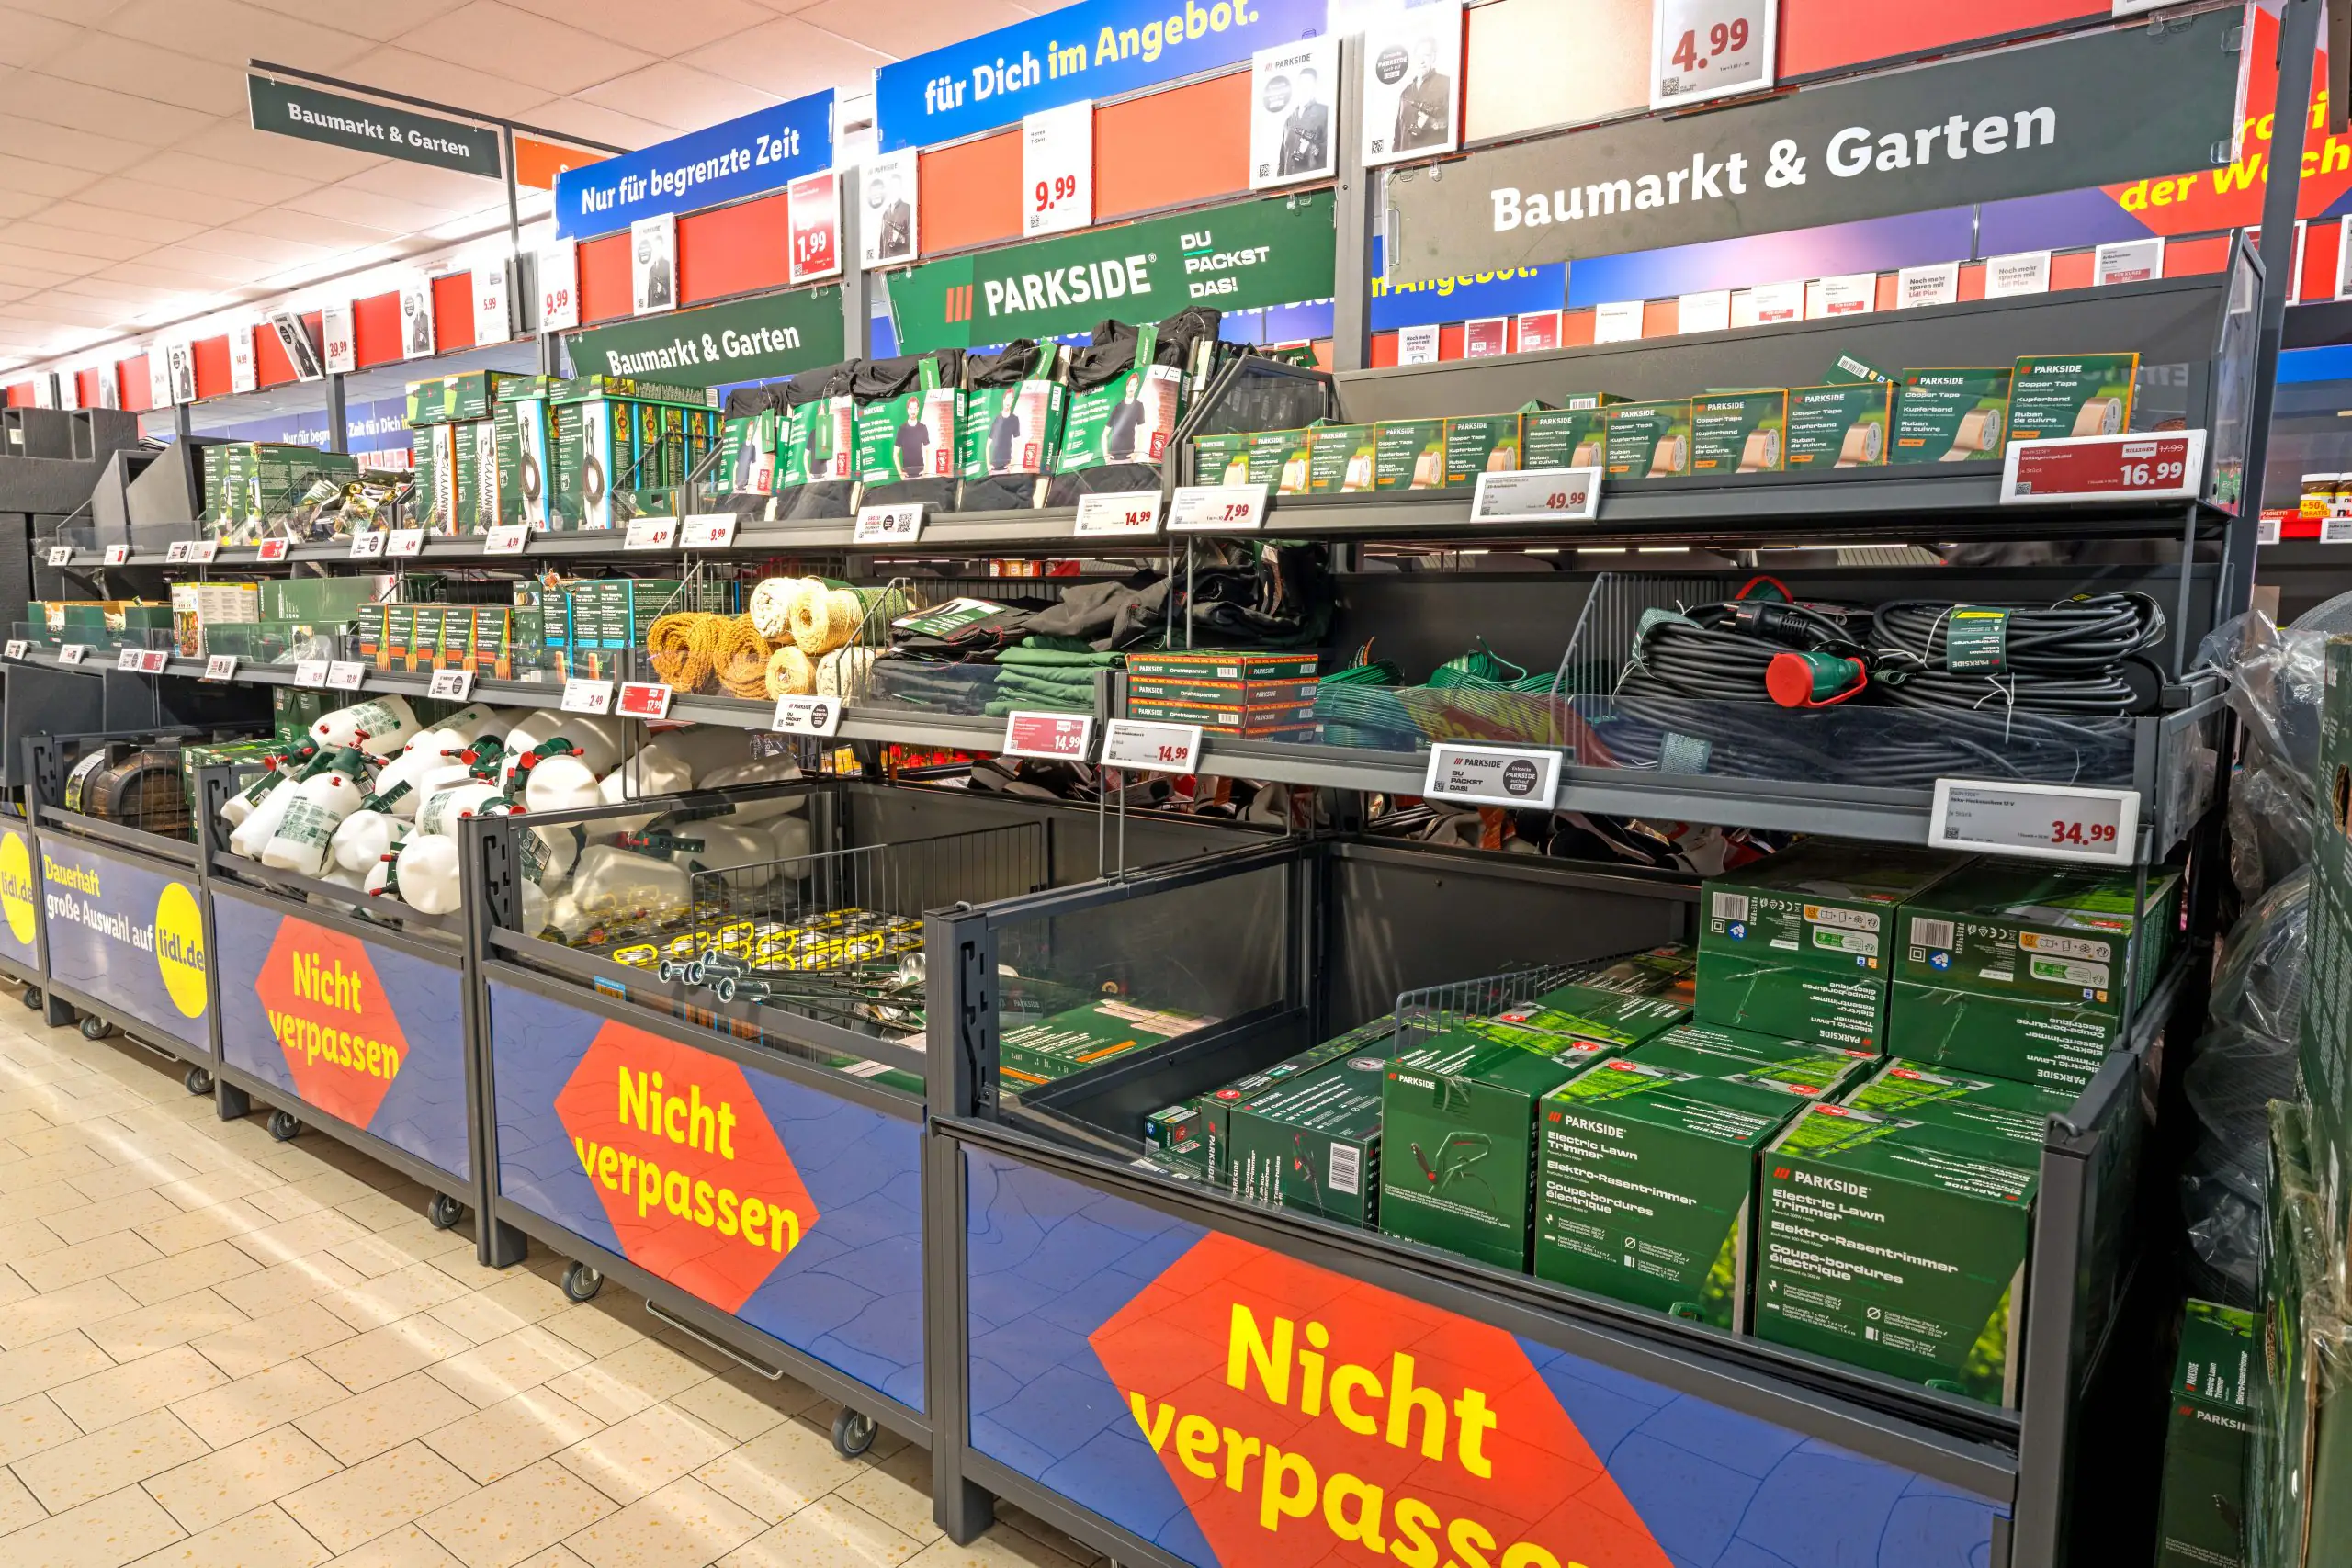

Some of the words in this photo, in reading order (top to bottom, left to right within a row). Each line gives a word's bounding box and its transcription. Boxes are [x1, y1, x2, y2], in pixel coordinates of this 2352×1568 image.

[1672, 18, 1748, 72] 4.99
[924, 77, 963, 115] für
[973, 52, 1040, 103] Dich
[1047, 40, 1087, 80] im
[1094, 0, 1259, 66] Angebot.
[288, 102, 385, 141] Baumarkt
[389, 125, 403, 144] &
[408, 130, 469, 158] Garten
[582, 186, 614, 215] Nur
[619, 176, 647, 205] für
[650, 148, 750, 197] begrenzte
[756, 127, 800, 167] Zeit
[1491, 152, 1747, 231] Baumarkt
[1764, 139, 1806, 188] &
[1826, 106, 2056, 177] Garten
[1035, 175, 1075, 212] 9.99
[2120, 175, 2197, 211] der
[797, 231, 827, 262] 1.99
[1181, 231, 1211, 250] DU
[1184, 246, 1270, 274] PACKST
[1188, 278, 1238, 298] DAS!
[484, 298, 496, 311] 5.99
[546, 288, 568, 317] 9.99
[330, 341, 347, 358] 39.99
[606, 334, 699, 377] Baumarkt
[701, 334, 720, 362] &
[721, 326, 800, 358] Garten
[2034, 365, 2082, 374] PARKSIDE
[1920, 377, 1964, 386] PARKSIDE
[1707, 402, 1744, 411] PARKSIDE
[1805, 394, 1845, 403] PARKSIDE
[1621, 410, 1655, 418] PARKSIDE
[1903, 406, 1953, 414] Kupferband
[348, 420, 366, 437] Zeit
[1540, 417, 1572, 425] PARKSIDE
[298, 429, 310, 445] für
[2159, 444, 2184, 453] 17.99
[2120, 462, 2183, 486] 16.99
[1546, 492, 1586, 509] 49.99
[1125, 512, 1151, 525] 14.99
[1224, 504, 1249, 521] 7.99
[507, 537, 519, 548] 4.99
[653, 531, 667, 544] 4.99
[710, 528, 726, 541] 9.99
[589, 695, 604, 707] 2.49
[647, 700, 662, 711] 17.99
[1055, 735, 1080, 750] 14.99
[1159, 746, 1188, 762] 14.99
[1464, 759, 1501, 768] PARKSIDE
[2052, 820, 2116, 846] 34.99
[44, 854, 100, 898] Dauerhaft
[1, 869, 34, 907] lidl.de
[47, 892, 81, 923] große
[82, 906, 130, 946] Auswahl
[131, 923, 153, 953] auf
[156, 927, 206, 973] lidl.de
[292, 951, 363, 1014] Nicht
[1803, 984, 1876, 1000] Coupe-bordures
[1810, 996, 1875, 1010] Rasentrimmer
[1838, 1007, 1874, 1017] Elektro-
[1811, 1017, 1835, 1026] Lawn
[1834, 1016, 1874, 1027] Trimmer
[1838, 1022, 1873, 1033] Electric
[2016, 1018, 2105, 1039] Coupe-bordures
[269, 1010, 399, 1080] verpassen
[1820, 1030, 1860, 1043] PARKSIDE
[2025, 1032, 2104, 1049] Rasentrimmer
[2059, 1044, 2103, 1056] Elektro-
[2026, 1055, 2056, 1066] Lawn
[2054, 1055, 2102, 1067] Trimmer
[1399, 1075, 1435, 1089] PARKSIDE
[2037, 1069, 2086, 1084] PARKSIDE
[618, 1066, 736, 1160] Nicht
[1566, 1115, 1626, 1139] PARKSIDE
[1547, 1140, 1603, 1160] Trimmer
[1548, 1131, 1598, 1150] Electric
[1601, 1143, 1638, 1160] Lawn
[1547, 1161, 1697, 1206] Elektro-Rasentrimmer
[1795, 1171, 1870, 1199] PARKSIDE
[574, 1136, 800, 1254] verpassen
[1546, 1190, 1612, 1214] électrique
[1547, 1181, 1653, 1217] Coupe-bordures
[1772, 1200, 1842, 1221] Trimmer
[1773, 1189, 1836, 1212] Electric
[1839, 1202, 1885, 1223] Lawn
[1771, 1222, 1959, 1274] Elektro-Rasentrimmer
[1770, 1243, 1904, 1285] Coupe-bordures
[1770, 1253, 1851, 1281] électrique
[1226, 1303, 1498, 1480] Nicht
[1129, 1392, 1589, 1568] verpass
